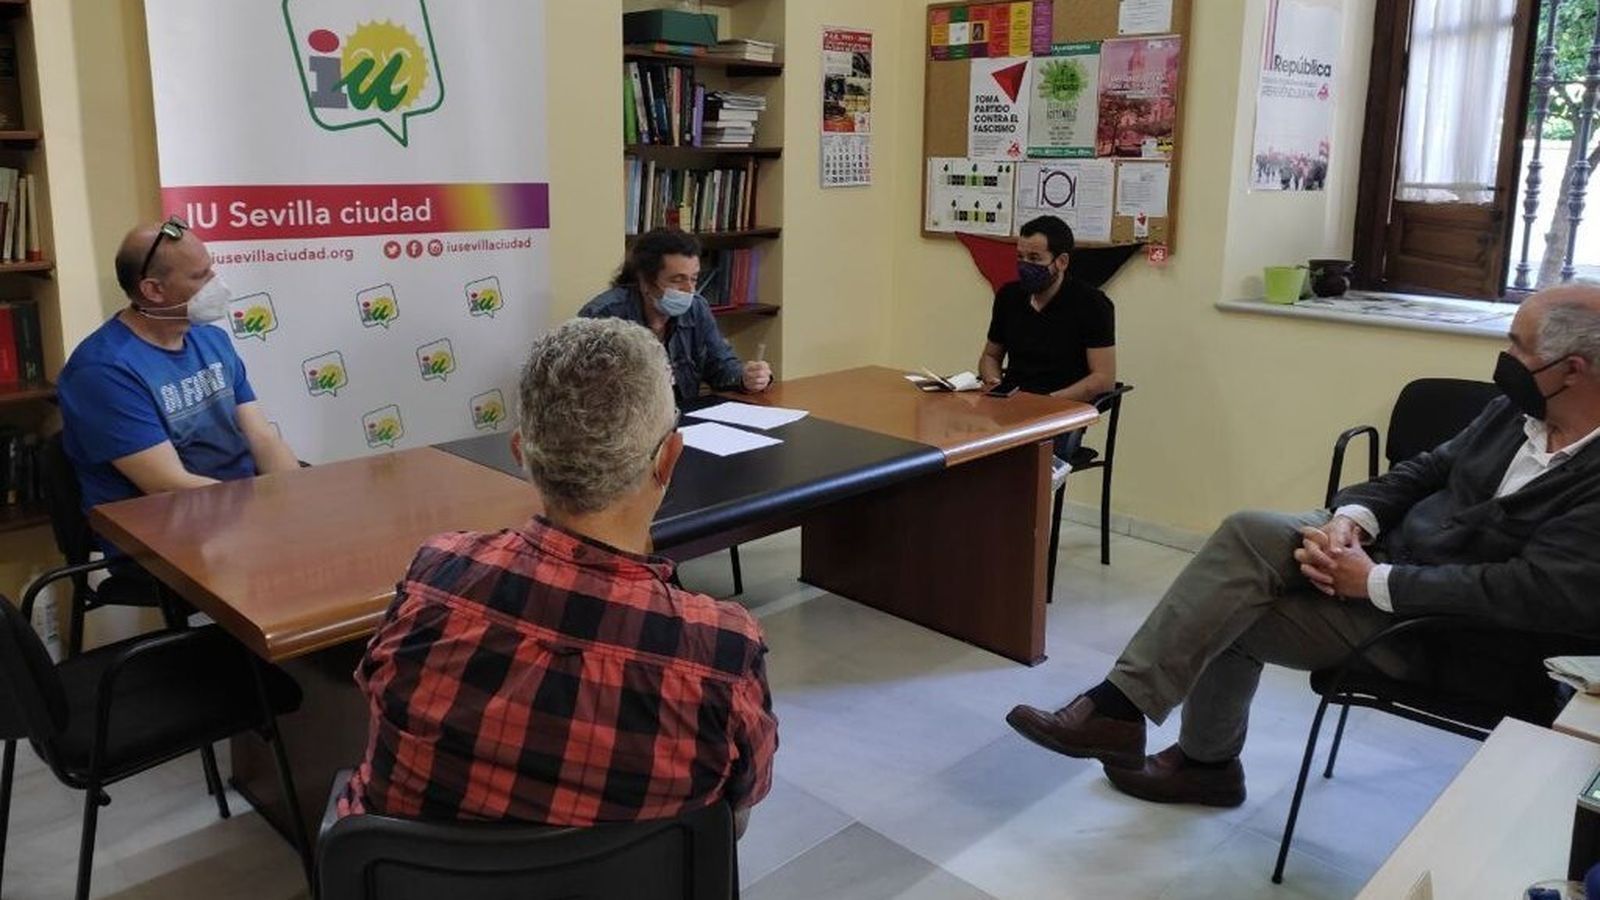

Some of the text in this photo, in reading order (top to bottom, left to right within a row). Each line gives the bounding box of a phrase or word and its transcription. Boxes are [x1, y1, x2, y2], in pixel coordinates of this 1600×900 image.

[1274, 54, 1332, 77] República
[975, 95, 1000, 104] TOMA
[974, 104, 1010, 113] PARTIDO
[974, 114, 1019, 123] CONTRA EL
[974, 124, 1017, 133] FASCISMO
[187, 197, 432, 229] IU Sevilla ciudad
[447, 237, 532, 253] iusevillaciudad
[211, 248, 354, 266] iusevillaciudad.org
